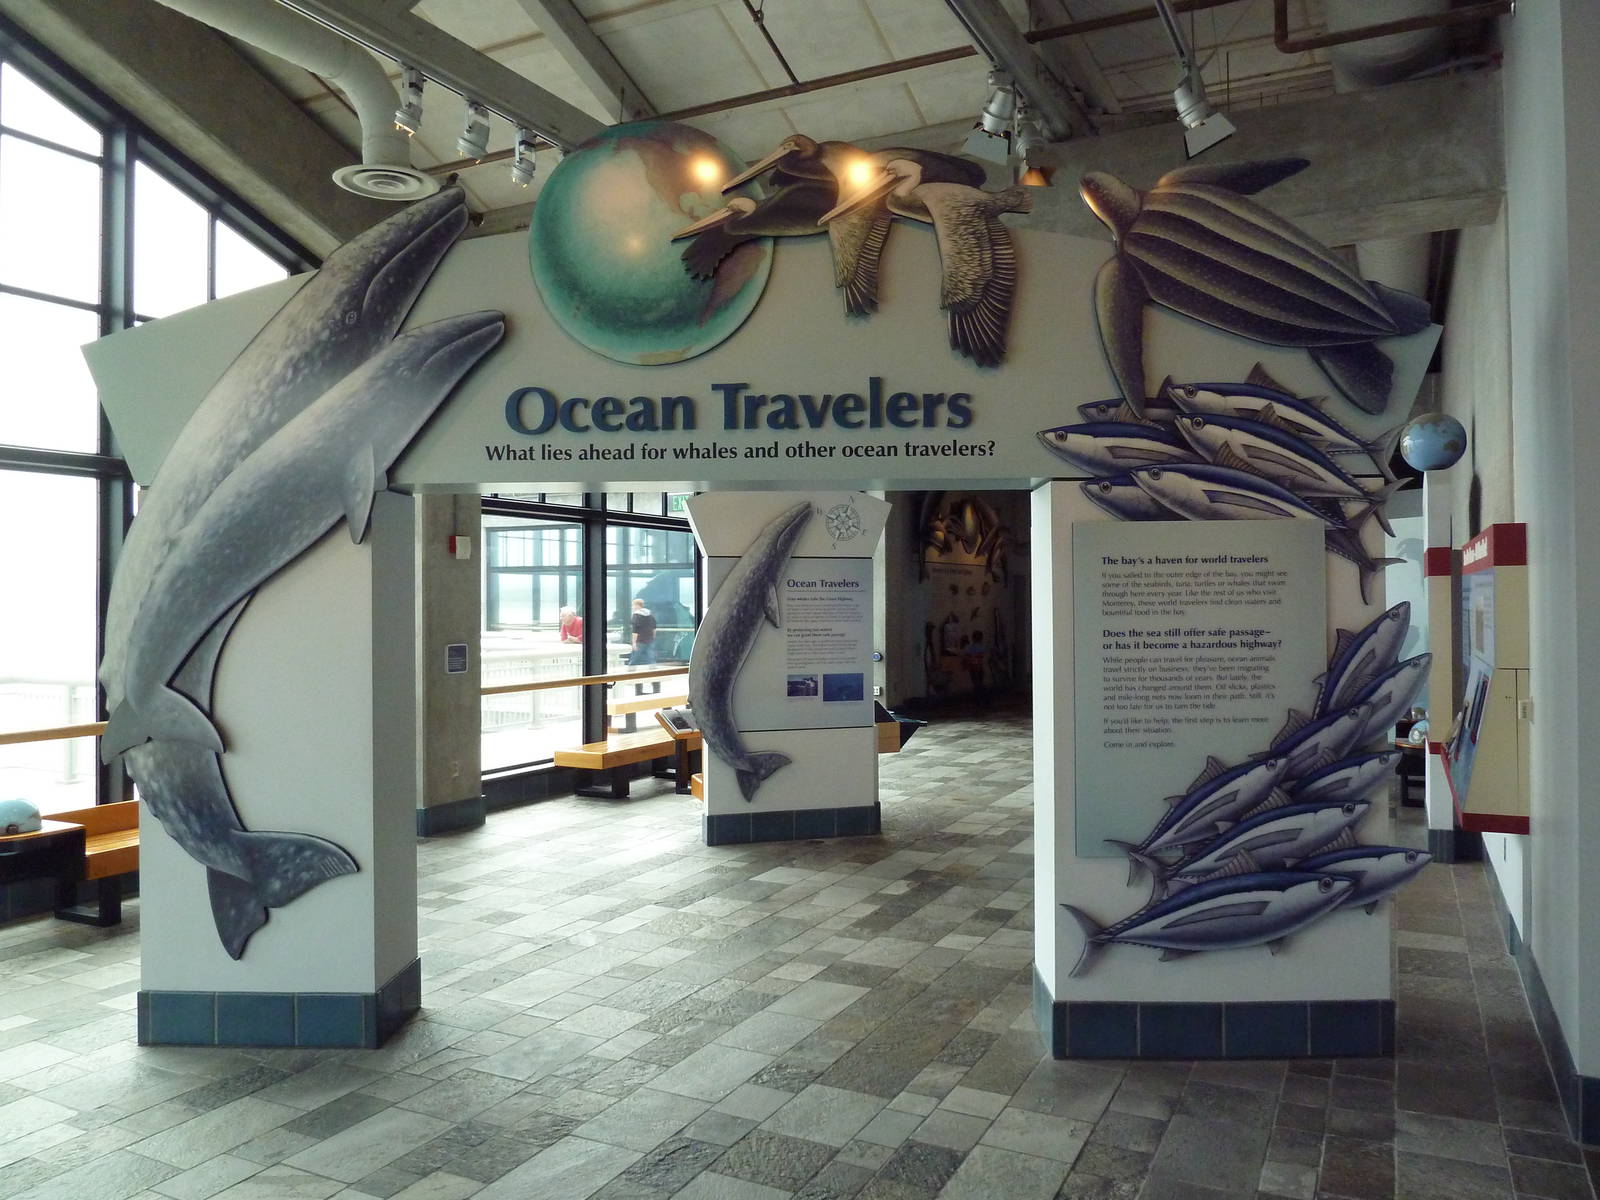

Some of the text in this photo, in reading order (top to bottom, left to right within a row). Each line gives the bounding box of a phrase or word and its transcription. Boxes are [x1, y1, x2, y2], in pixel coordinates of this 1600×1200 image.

[505, 377, 974, 435] Ocean Travelers
[485, 440, 996, 461] What lies ahead for whales and other ocean travelers?
[673, 496, 688, 510] EX
[1102, 556, 1119, 565] The
[1121, 556, 1144, 567] bay's
[1155, 556, 1182, 564] haven
[1185, 555, 1198, 564] for
[1200, 555, 1227, 564] world
[1230, 555, 1268, 563] travelers
[787, 579, 859, 588] Ocean Travelers
[1103, 629, 1126, 637] Does
[1128, 629, 1144, 637] the
[1164, 628, 1180, 637] still
[1183, 628, 1205, 637] offer
[1207, 628, 1226, 637] safe
[1115, 641, 1131, 650] has
[1143, 641, 1179, 649] become
[1190, 640, 1237, 649] hazardous
[1240, 640, 1282, 651] highway?
